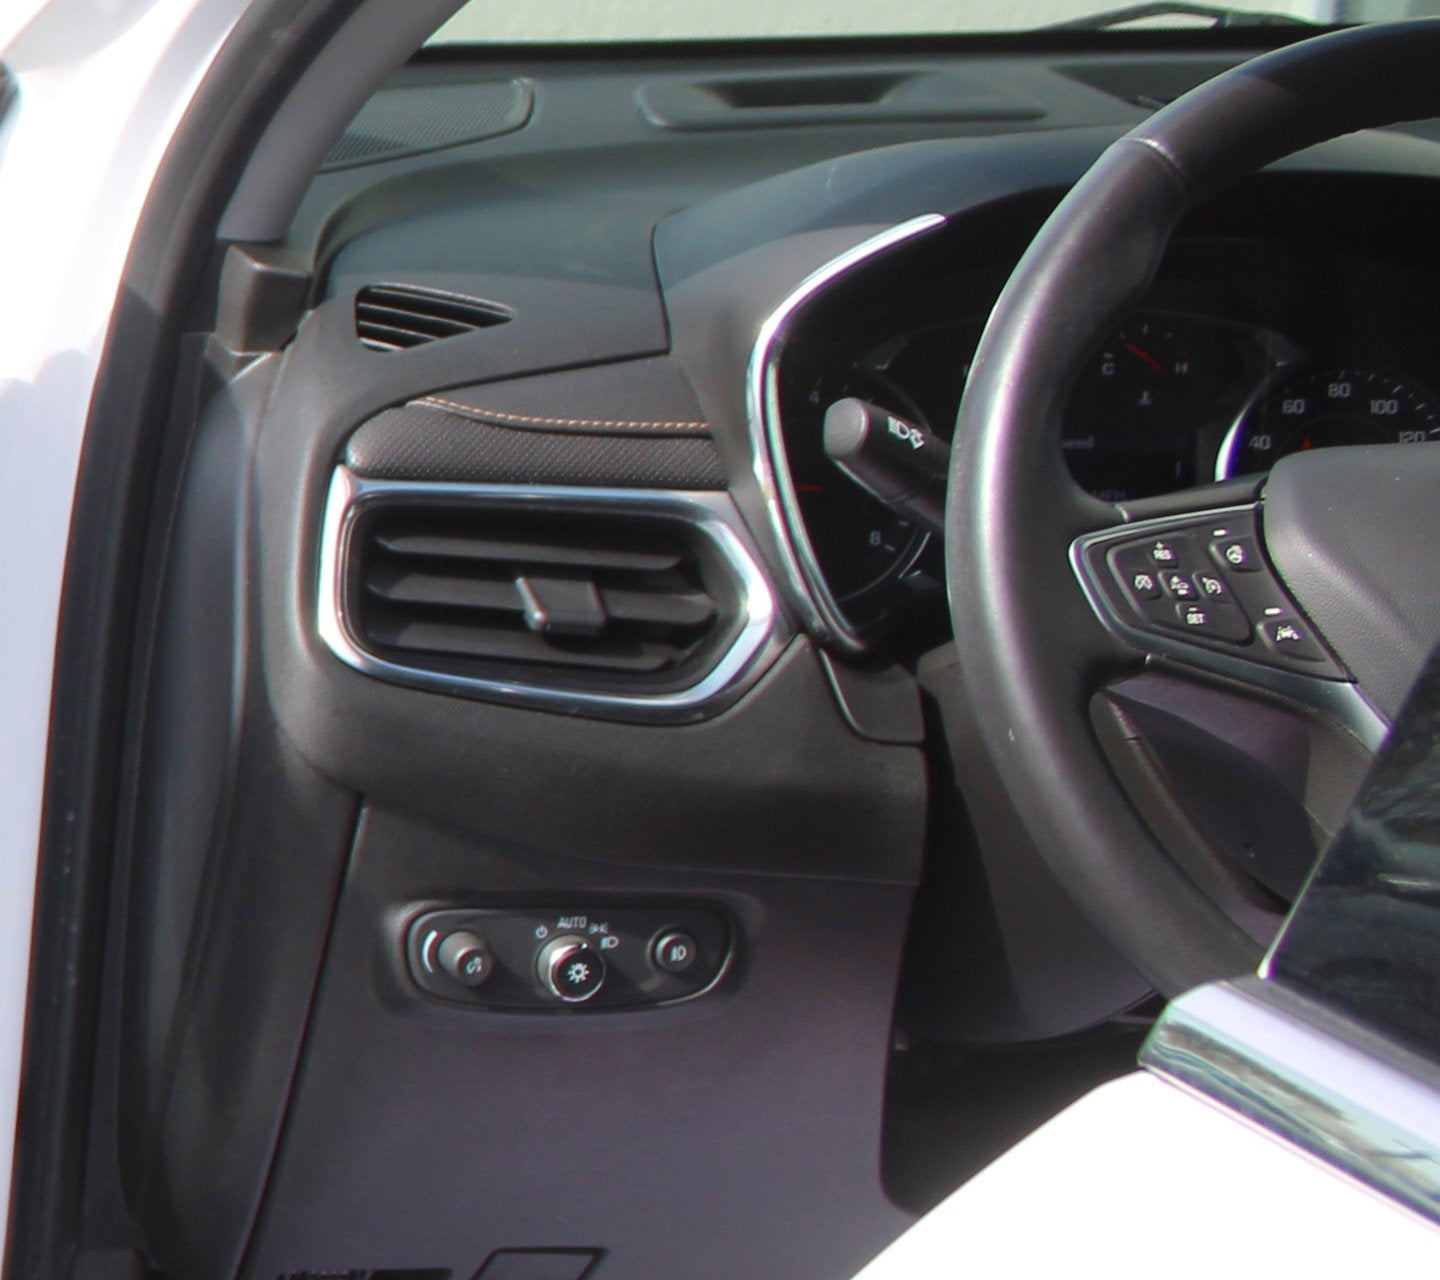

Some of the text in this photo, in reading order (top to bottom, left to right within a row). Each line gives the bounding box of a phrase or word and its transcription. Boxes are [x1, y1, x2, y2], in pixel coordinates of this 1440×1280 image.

[1327, 382, 1352, 399] 80
[1282, 398, 1307, 415] 60
[1370, 398, 1398, 415] 100
[1247, 433, 1273, 451] 40
[557, 916, 588, 930] AUTO
